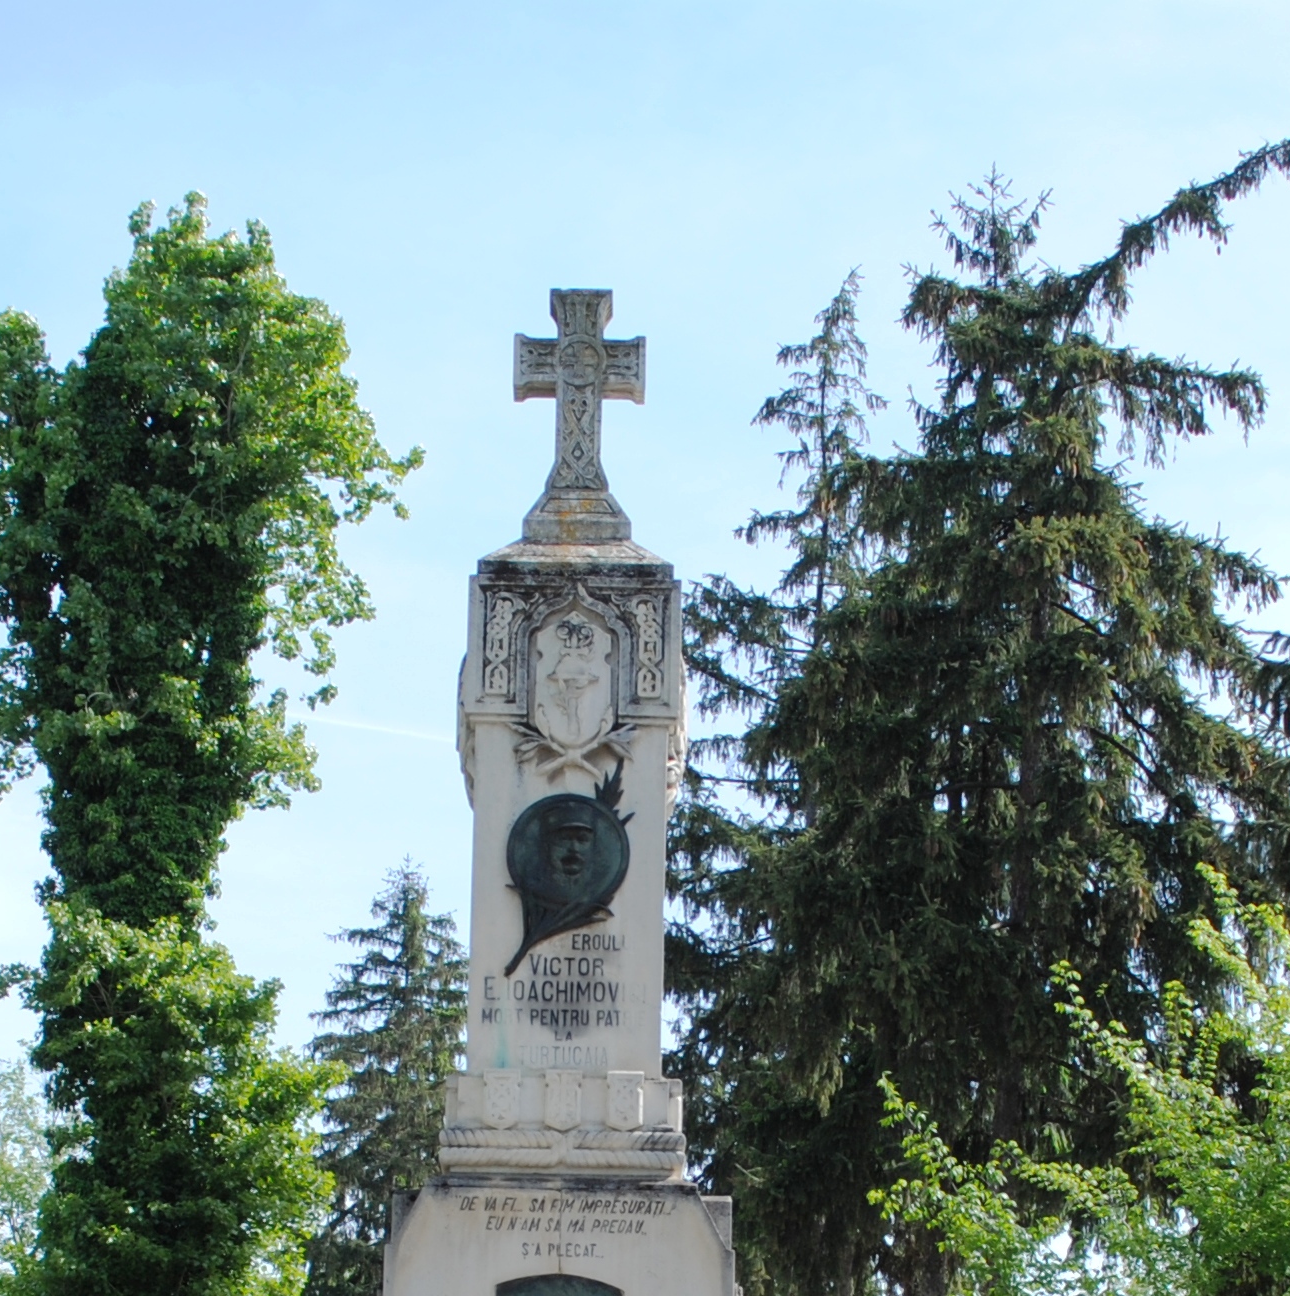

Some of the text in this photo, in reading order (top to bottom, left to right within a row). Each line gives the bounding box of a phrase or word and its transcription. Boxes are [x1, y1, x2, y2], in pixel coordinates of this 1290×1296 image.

[529, 953, 605, 977] VICTOR
[483, 975, 501, 1001] E.
[529, 1008, 590, 1027] PENTRU
[554, 1029, 573, 1042] LA
[519, 1045, 609, 1068] TURTUCAIA
[483, 1196, 498, 1212] VA
[485, 1215, 505, 1231] EU
